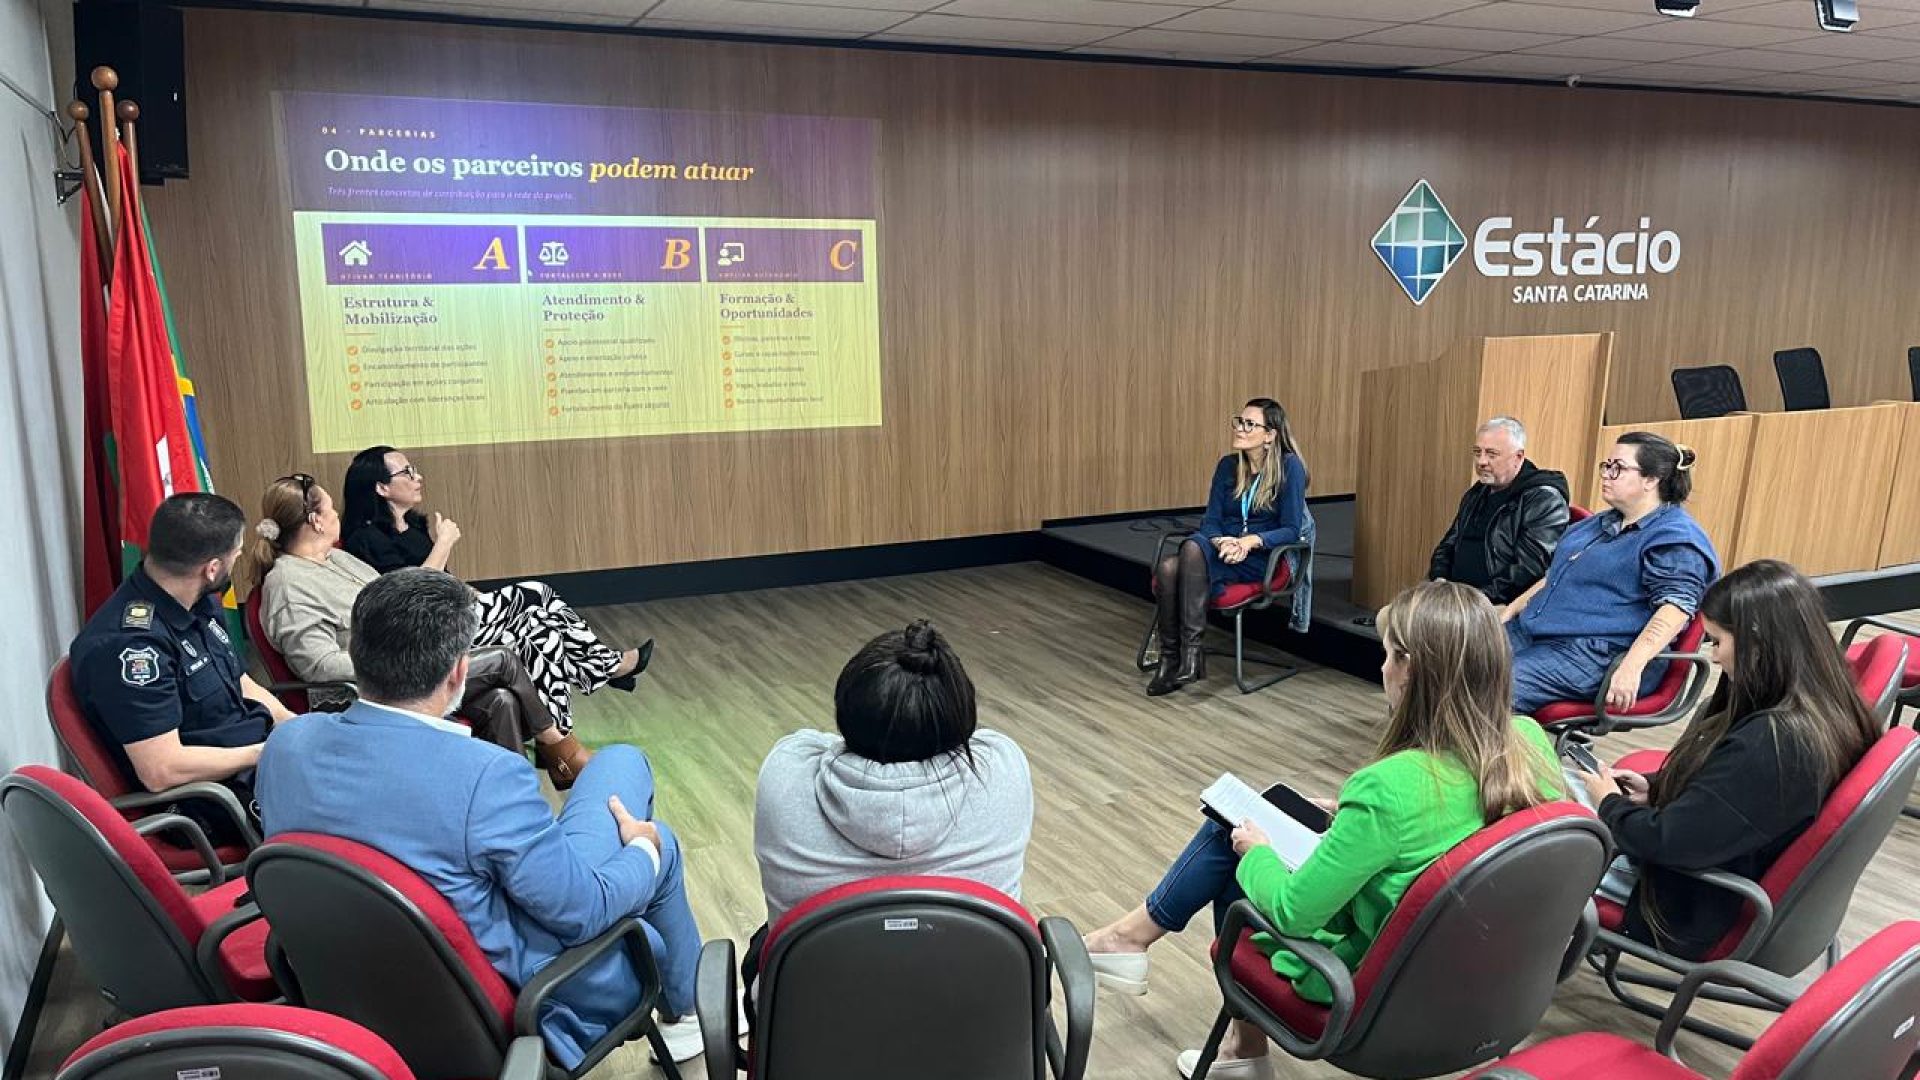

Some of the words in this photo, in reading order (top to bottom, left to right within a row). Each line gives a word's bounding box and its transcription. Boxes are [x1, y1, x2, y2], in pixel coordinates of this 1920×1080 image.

[359, 128, 436, 139] PARCERIAS
[325, 149, 406, 172] Onde
[413, 156, 446, 174] os
[452, 153, 583, 180] parceiros
[588, 156, 677, 183] podem
[683, 162, 754, 181] atuar
[473, 236, 511, 271] A
[1473, 215, 1681, 277] Estácio
[660, 239, 691, 270] B
[830, 239, 857, 271] C
[543, 294, 632, 306] Atendimento
[635, 294, 645, 305] &
[719, 293, 782, 306] Formação
[785, 293, 795, 304] &
[1512, 285, 1568, 304] SANTA
[1573, 283, 1649, 302] CATARINA
[344, 296, 419, 309] Estrutura
[422, 297, 433, 308] &
[345, 312, 438, 327] Mobilização
[543, 309, 605, 323] Proteção
[720, 307, 813, 320] Oportunidades
